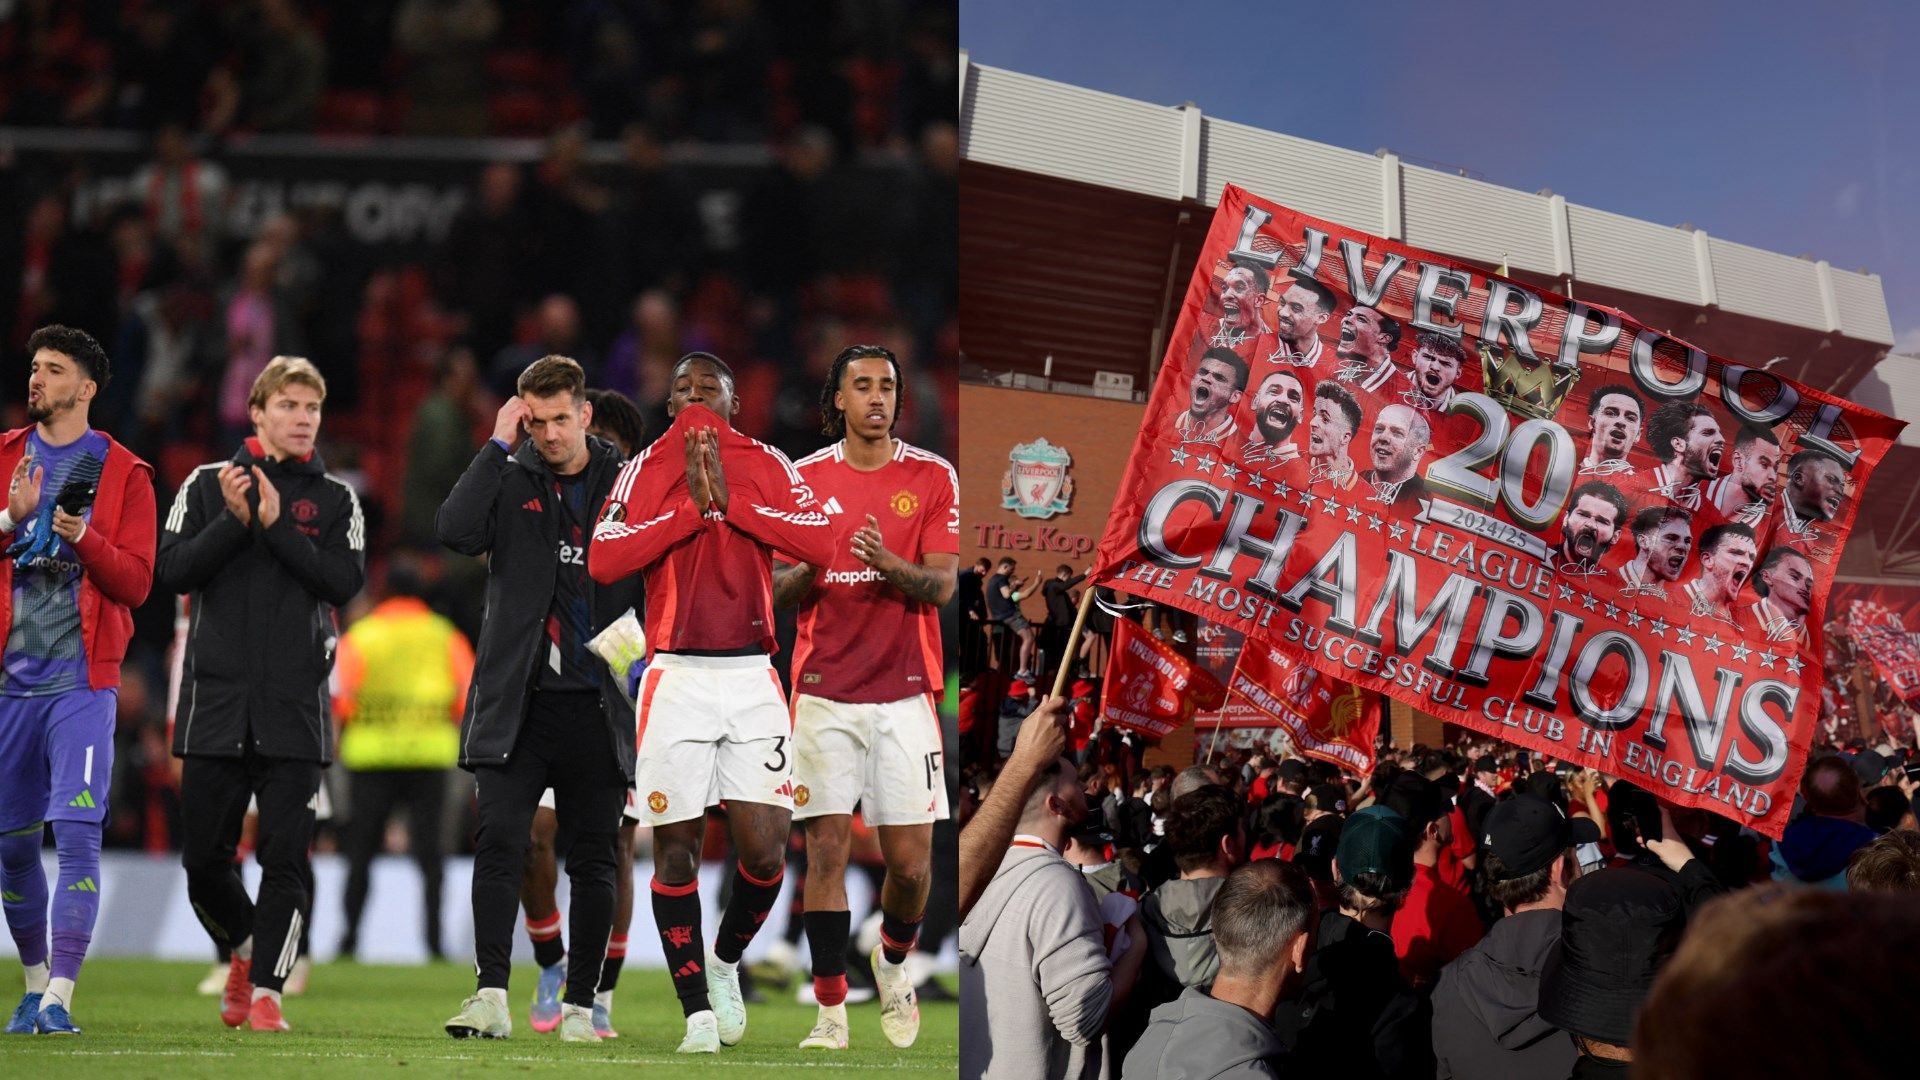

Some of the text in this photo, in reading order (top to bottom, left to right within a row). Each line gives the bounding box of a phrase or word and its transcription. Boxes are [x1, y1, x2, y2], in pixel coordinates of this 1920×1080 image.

[1227, 204, 1859, 470] LIVERPOOL
[1017, 465, 1060, 477] LIVERPOOL
[1424, 391, 1577, 532] 20
[974, 521, 1095, 560] The Kop
[1452, 508, 1528, 548] 2024/25
[1409, 523, 1555, 600] LEAGUE
[1137, 479, 1801, 786] CHAMPIONS
[1128, 637, 1188, 691] LIVERPOOL FC
[1268, 649, 1291, 669] 2024
[1114, 559, 1772, 817] THE MOST SUCCESSFUL CLUB IN ENGLAND
[1234, 675, 1283, 716] PREMIER
[1317, 688, 1331, 704] 202
[84, 744, 94, 786] 1
[764, 735, 790, 772] 3
